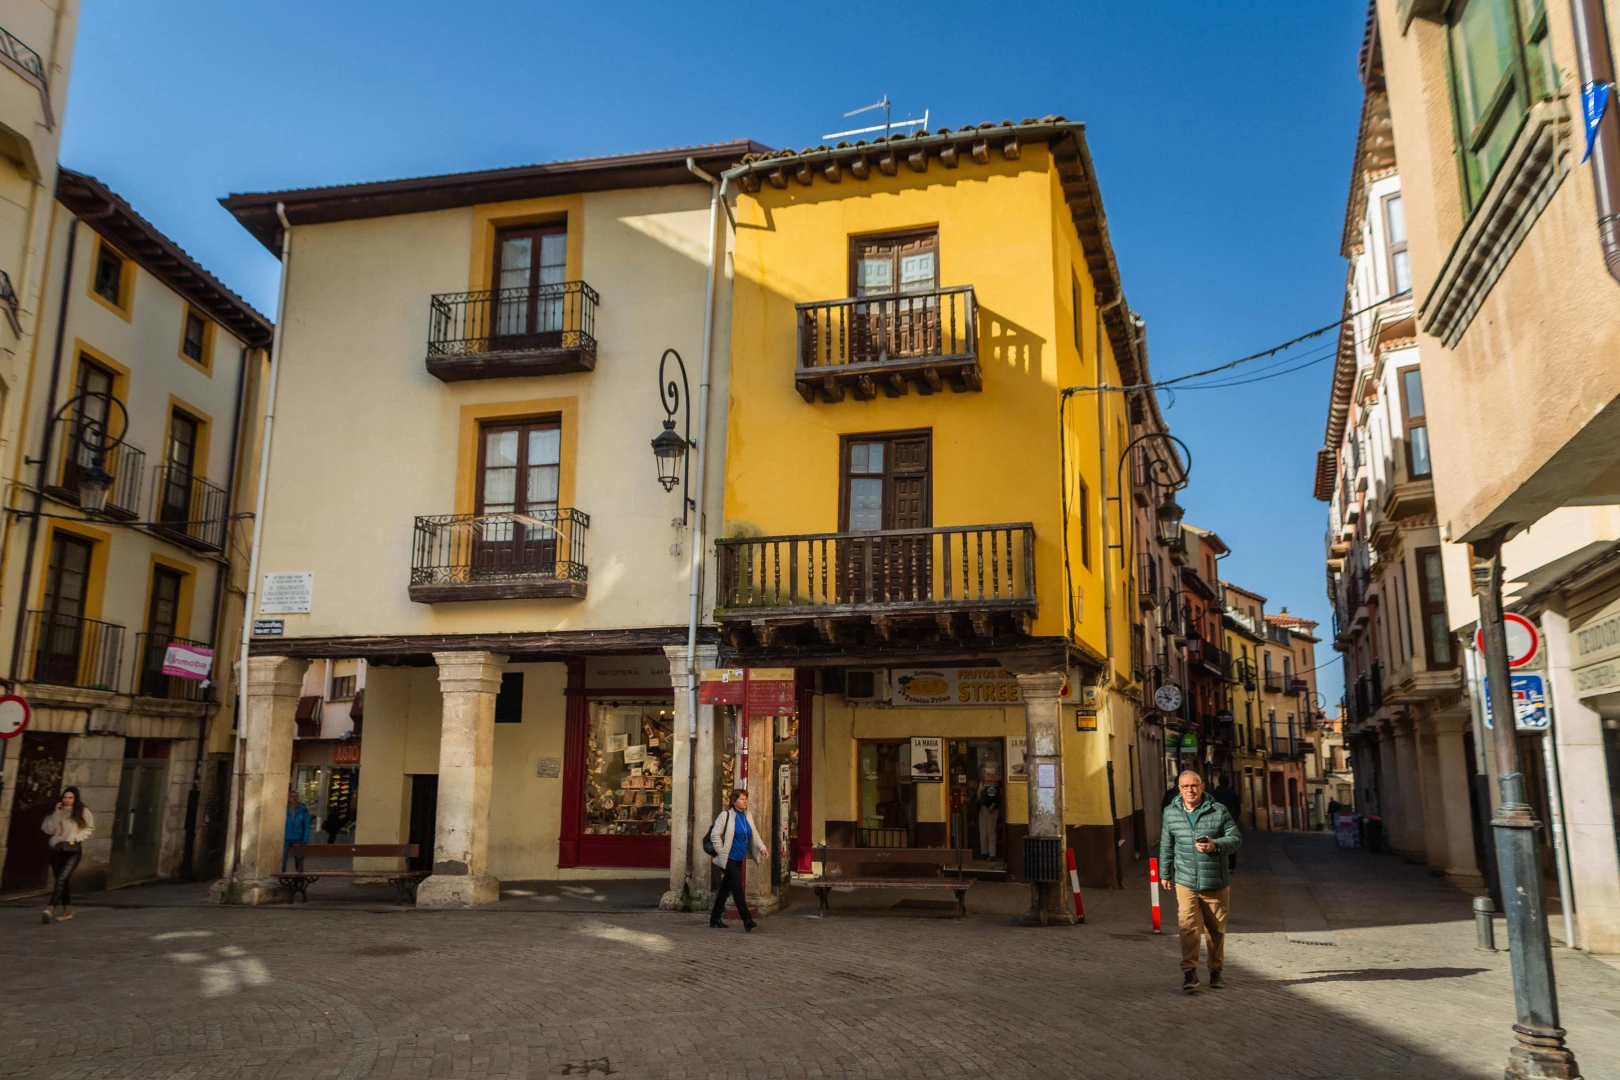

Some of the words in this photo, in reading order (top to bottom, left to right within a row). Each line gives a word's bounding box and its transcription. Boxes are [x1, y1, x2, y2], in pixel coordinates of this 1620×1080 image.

[914, 670, 944, 678] Artesanas
[958, 669, 996, 679] FRUTOS
[958, 681, 1022, 702] STREE
[931, 695, 951, 703] Fritas
[922, 739, 939, 747] MAGIA
[335, 745, 359, 760] JUSTO
